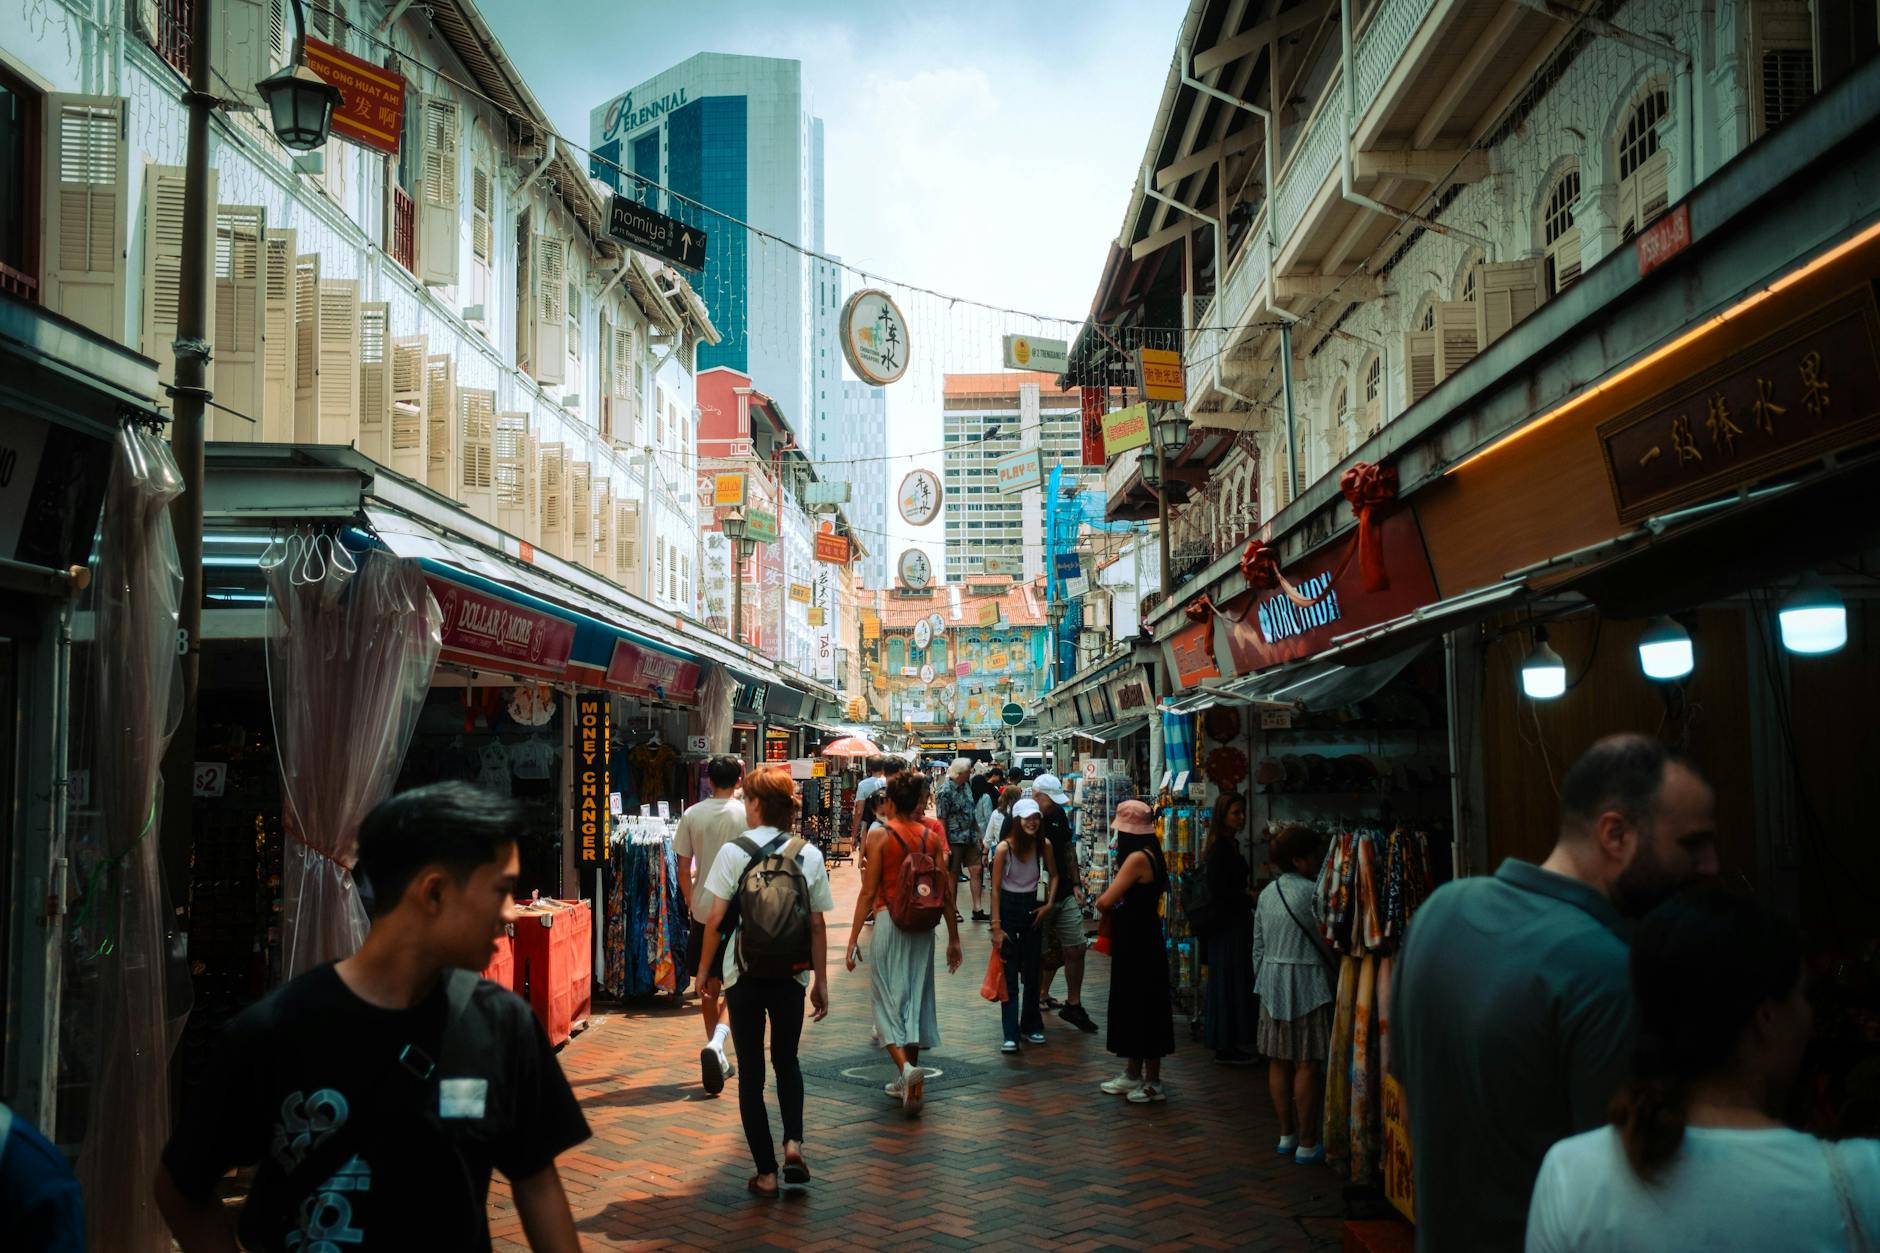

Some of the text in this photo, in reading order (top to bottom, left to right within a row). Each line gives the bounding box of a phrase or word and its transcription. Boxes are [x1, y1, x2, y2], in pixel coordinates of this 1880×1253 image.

[332, 69, 354, 84] ONG
[355, 80, 381, 97] HUAT
[603, 87, 687, 141] PERENNIAL
[614, 208, 666, 240] nomiya
[879, 303, 900, 372] 牛车水
[1000, 463, 1025, 482] PLAY
[458, 600, 500, 636] DOLLAR
[496, 609, 508, 646] &
[506, 614, 534, 644] MORE
[820, 633, 830, 658] TAS
[581, 702, 597, 765] MONEY
[693, 738, 705, 749] $5
[196, 768, 218, 791] $2
[581, 771, 597, 861] CHANGER
